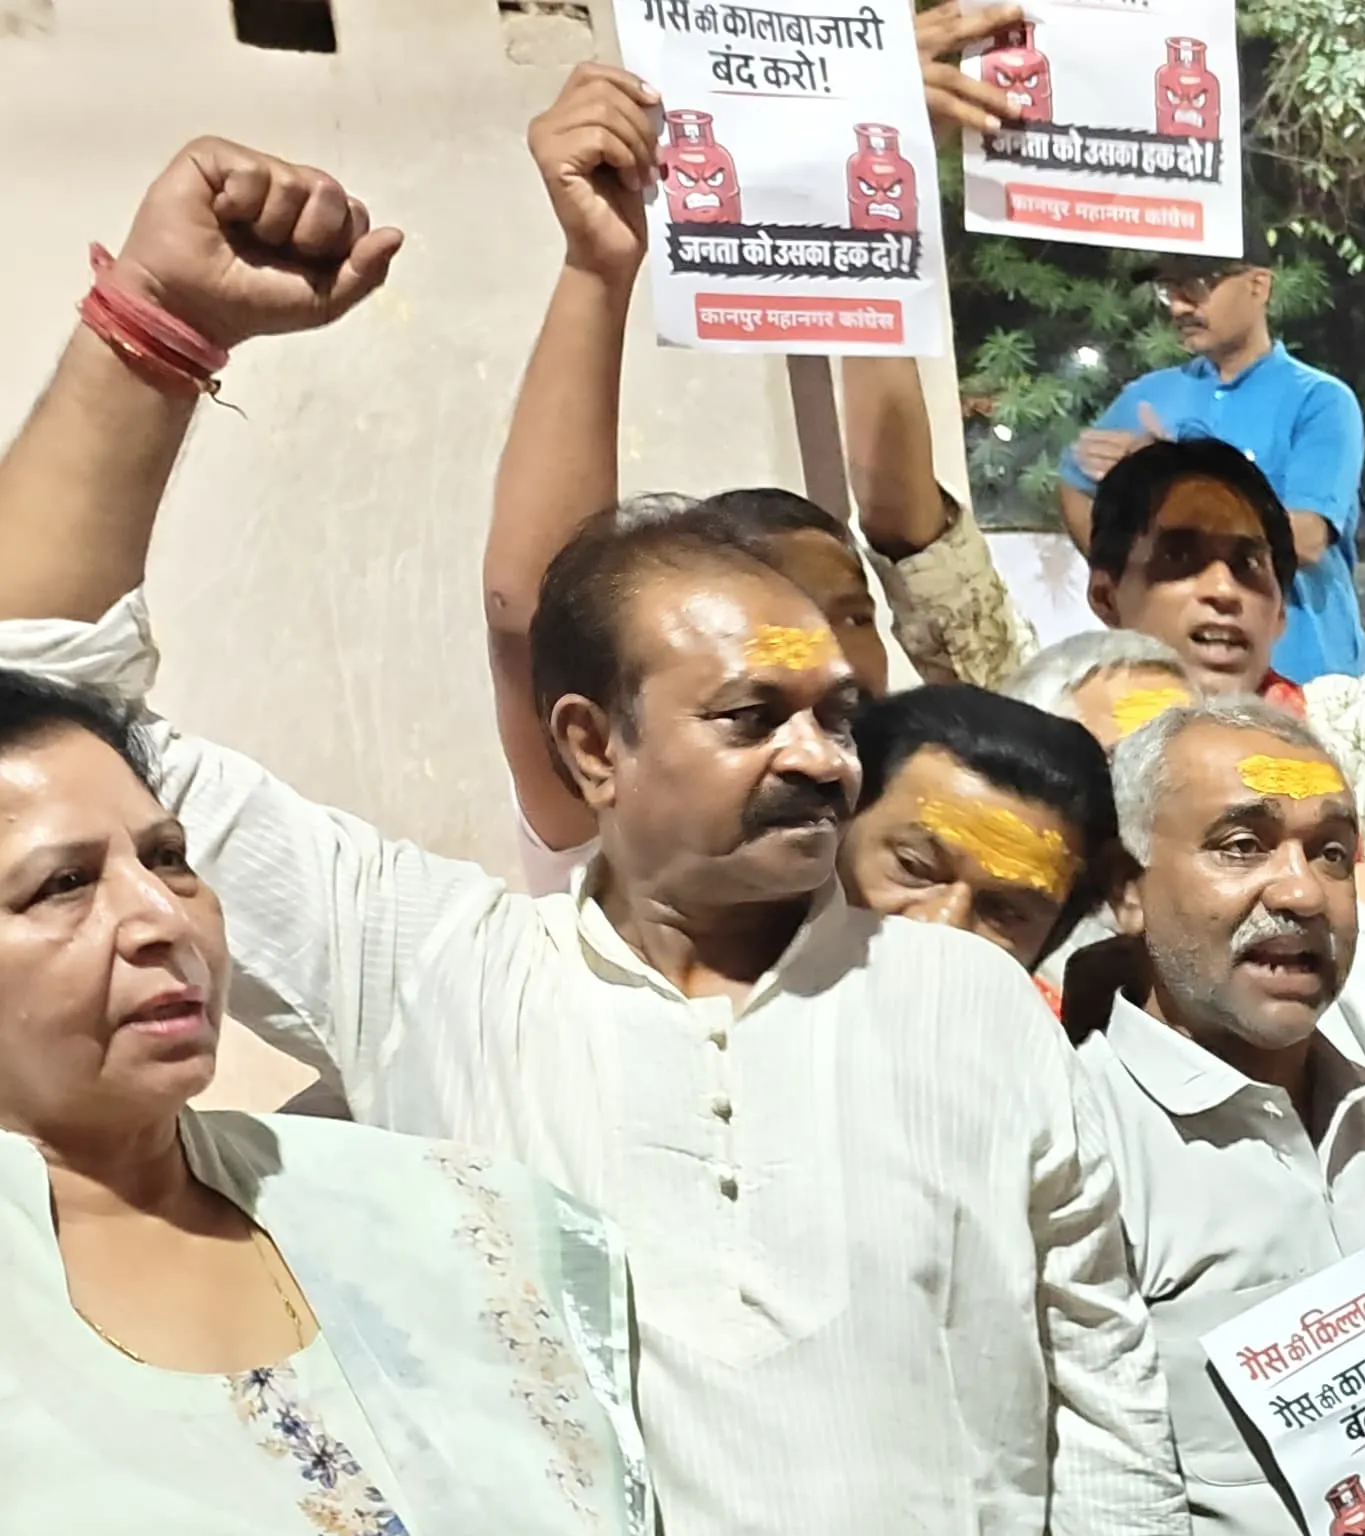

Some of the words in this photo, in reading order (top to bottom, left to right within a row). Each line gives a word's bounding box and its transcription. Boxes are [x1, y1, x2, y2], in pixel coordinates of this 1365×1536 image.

[694, 4, 719, 35] की
[720, 4, 884, 50] कालाबाजारी
[708, 44, 757, 89] बंद
[760, 50, 831, 93] करो!
[1052, 127, 1083, 165] को
[1084, 136, 1139, 169] उसका
[1142, 141, 1176, 174] हक
[678, 235, 739, 265] जनता
[742, 230, 773, 267] को
[774, 240, 831, 267] उसका
[833, 240, 870, 272] हक
[871, 233, 912, 273] दो!
[699, 307, 762, 332] कानपुर
[766, 308, 833, 330] महानगर
[1236, 1343, 1290, 1380] गैस
[1284, 1333, 1312, 1362] की
[1269, 1393, 1323, 1430] गैस
[1315, 1384, 1342, 1410] की
